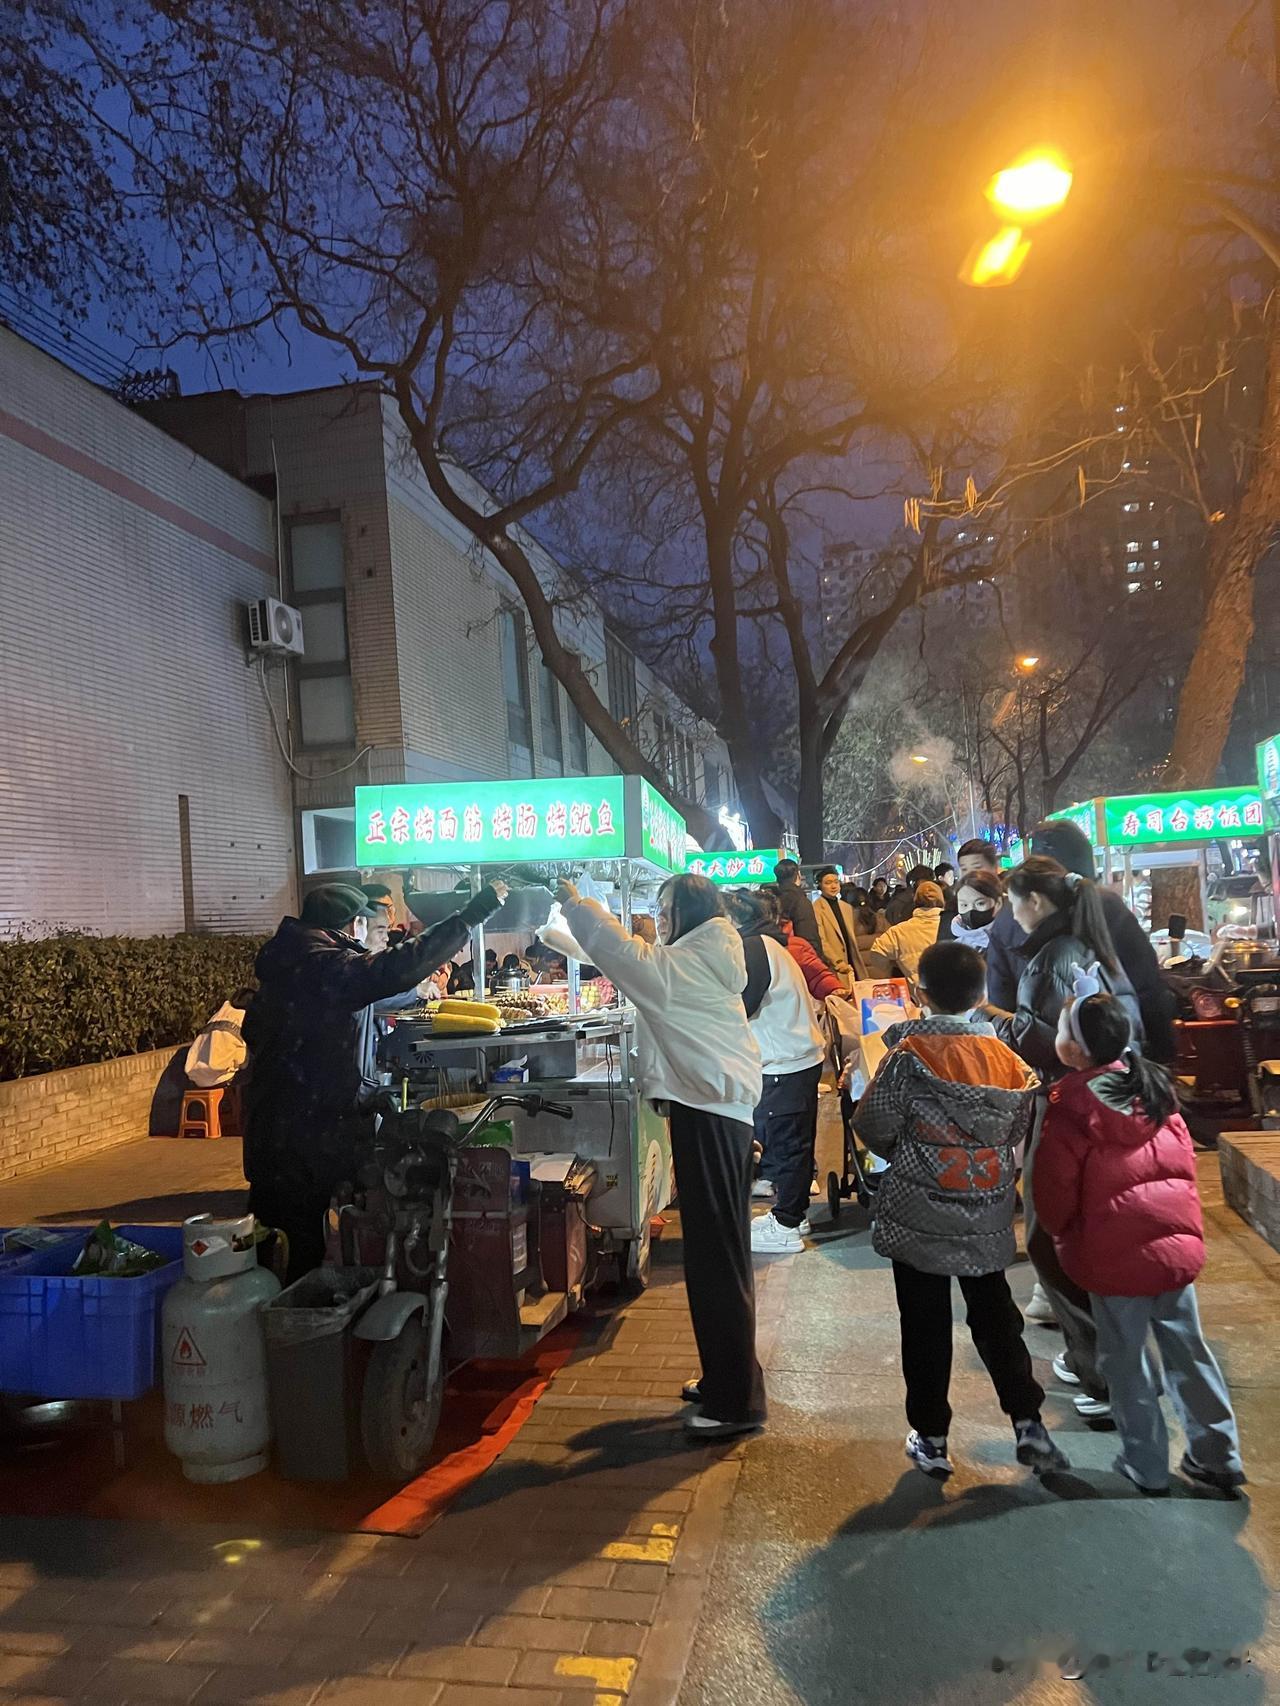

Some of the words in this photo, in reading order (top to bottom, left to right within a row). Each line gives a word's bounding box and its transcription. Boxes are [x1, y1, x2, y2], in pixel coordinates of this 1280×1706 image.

[365, 804, 483, 844] 正宗烤面筋
[493, 804, 537, 839] 烤肠
[547, 799, 616, 838] 烤鱿鱼
[1122, 801, 1263, 837] 寿司台湾饭团
[937, 1146, 1001, 1190] 23
